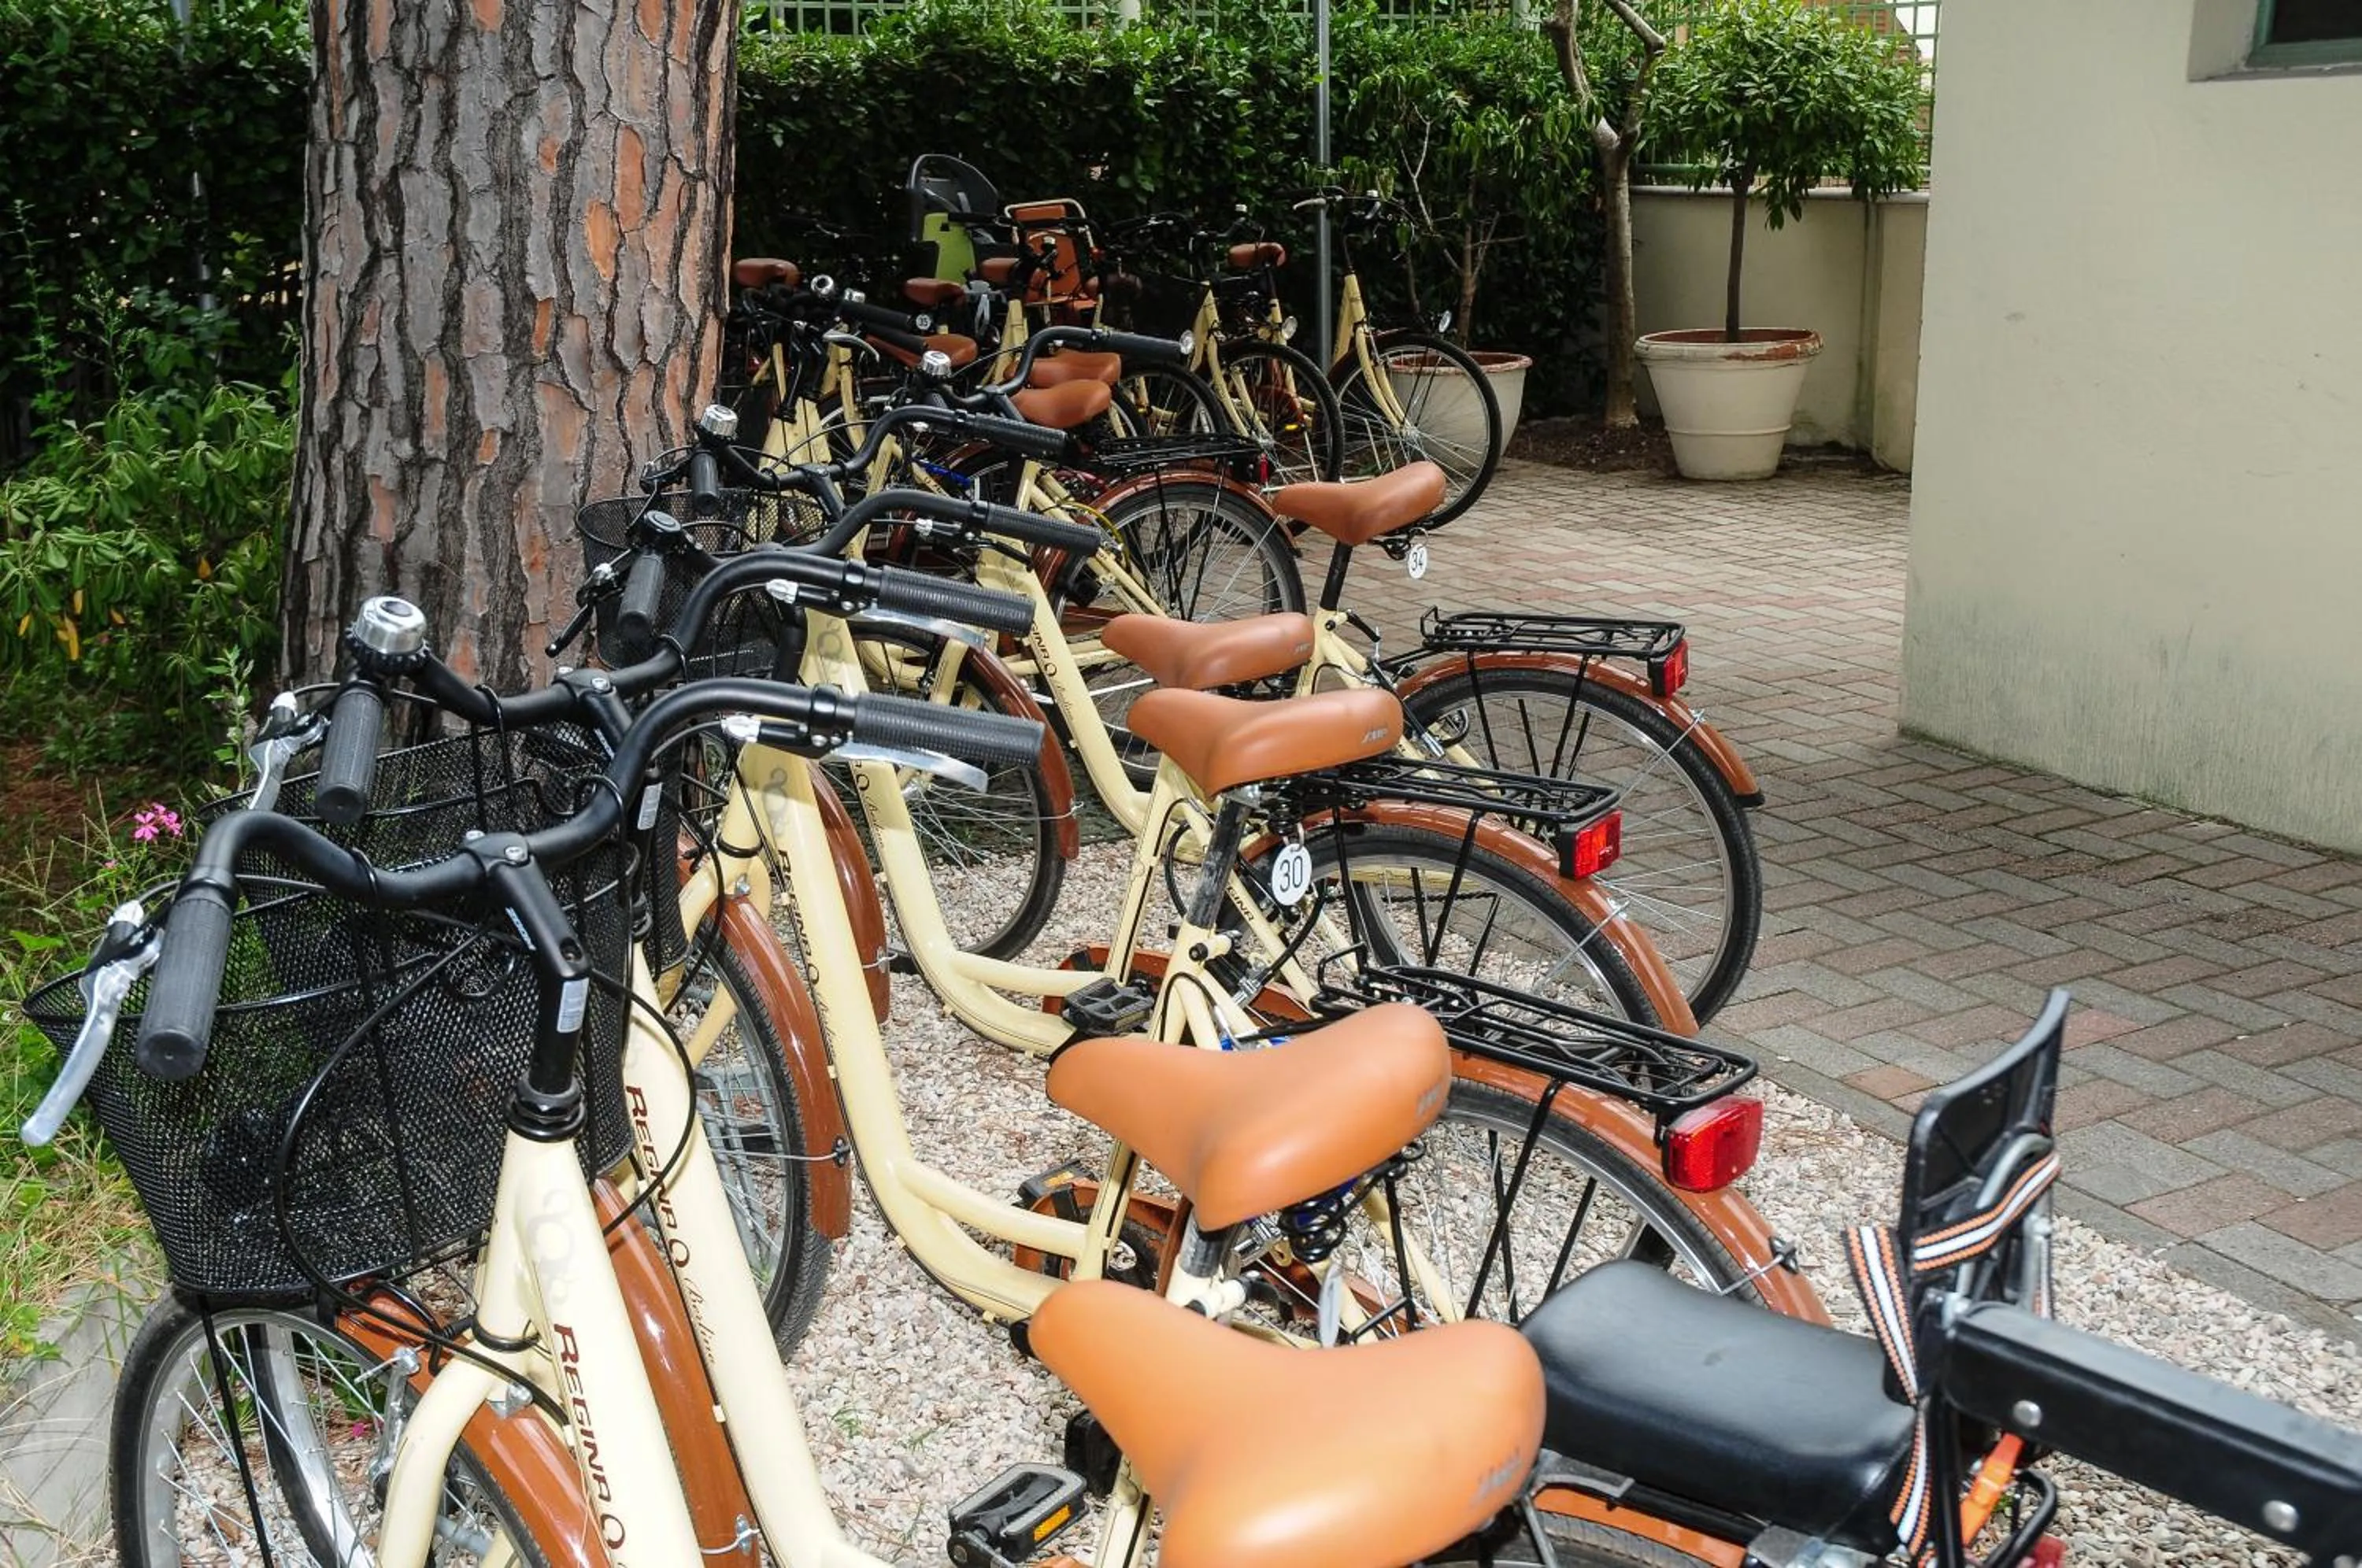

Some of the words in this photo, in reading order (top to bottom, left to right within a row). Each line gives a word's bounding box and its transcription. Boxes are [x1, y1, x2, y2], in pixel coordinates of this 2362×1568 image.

[1412, 552, 1423, 571] 34
[1280, 856, 1302, 893] 30
[553, 1323, 612, 1502] REGINA
